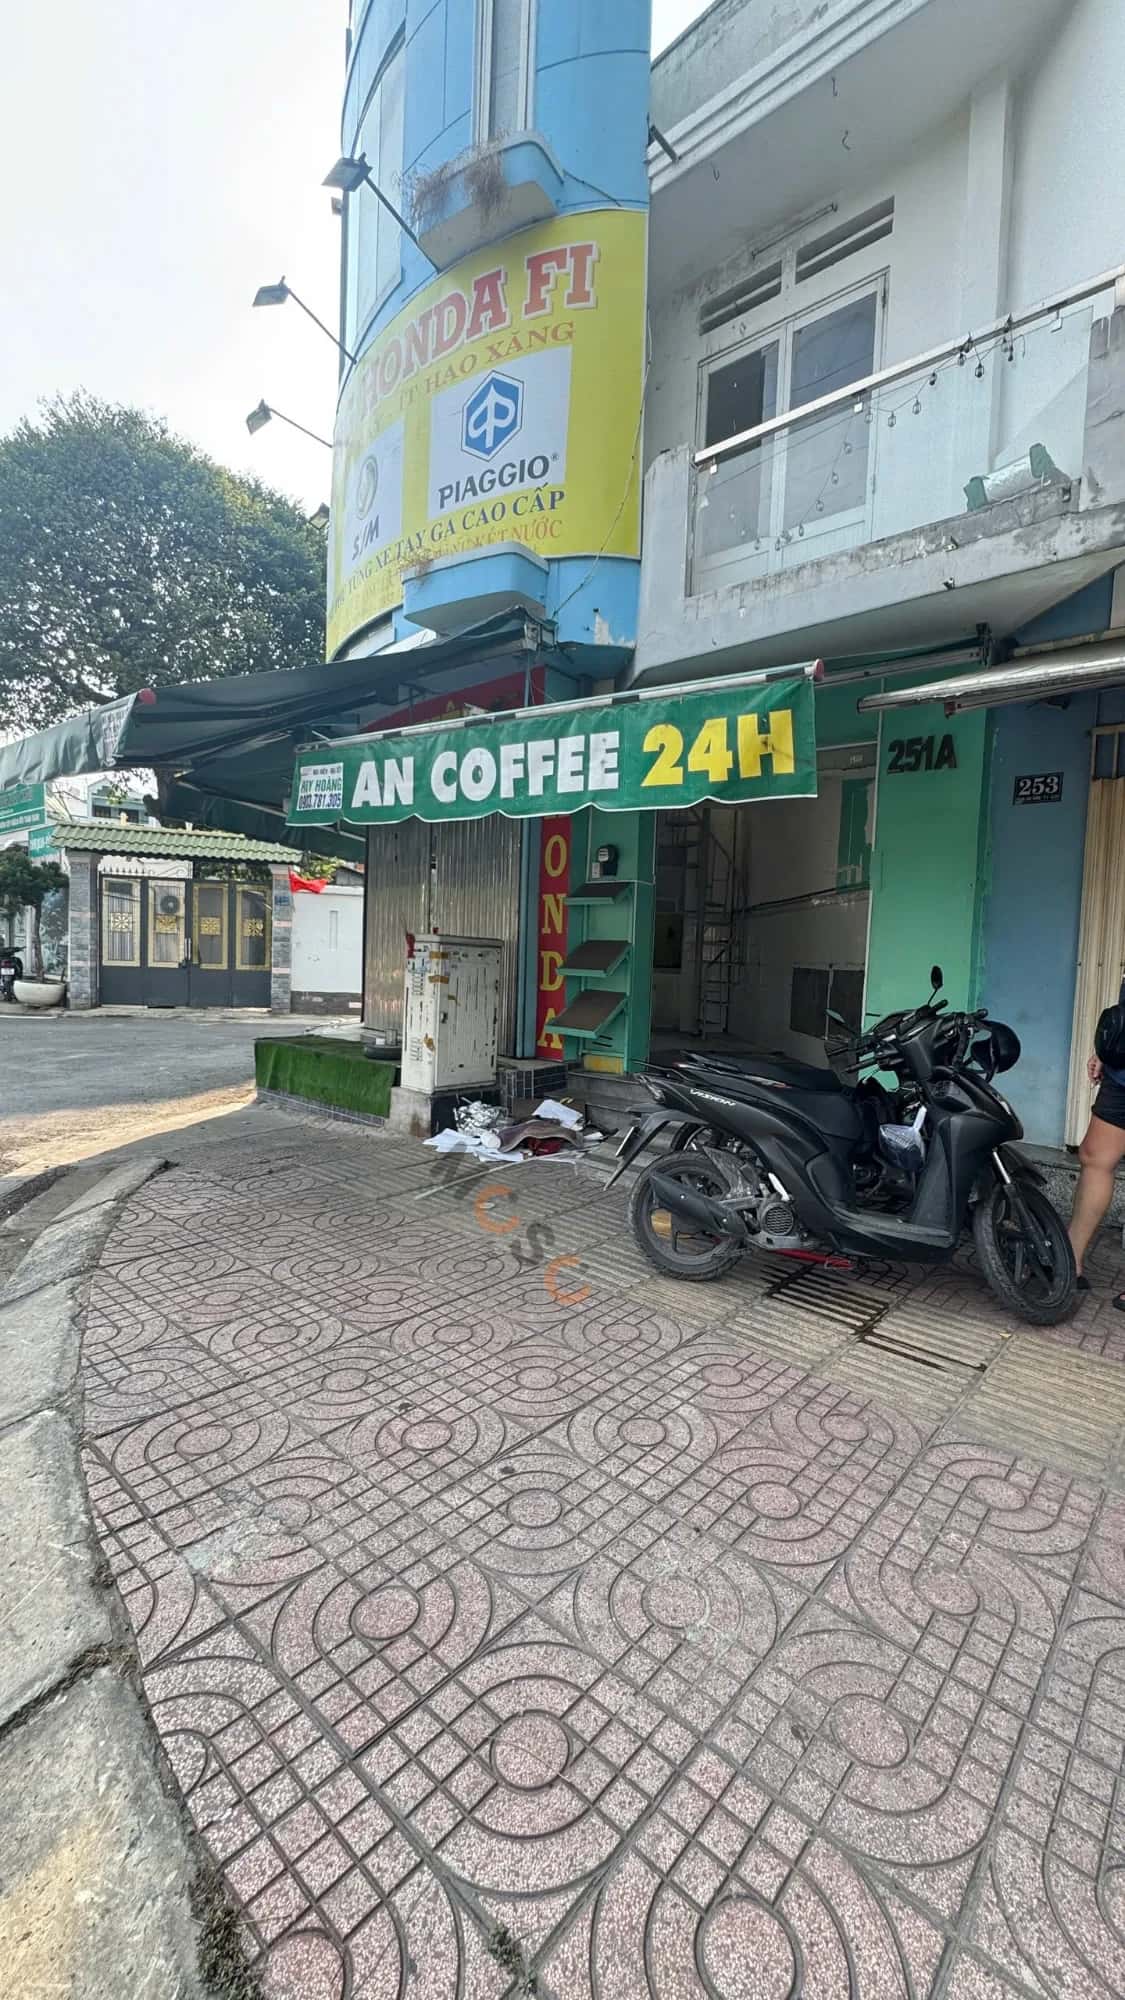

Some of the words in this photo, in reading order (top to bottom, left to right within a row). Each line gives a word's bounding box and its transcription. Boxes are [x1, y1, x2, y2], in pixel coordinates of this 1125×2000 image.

[358, 265, 508, 417] HONDA
[523, 243, 599, 319] FI
[426, 351, 478, 394] HAO
[486, 320, 576, 363] XĂNG
[430, 519, 455, 543] GA
[461, 501, 507, 532] CAO
[512, 482, 566, 516] CẤP
[438, 456, 550, 510] PIAGGIO
[351, 756, 414, 808] AN
[430, 730, 620, 804] COFFEE
[640, 708, 796, 788] 24H
[887, 734, 958, 775] 251A
[1019, 775, 1059, 796] 253
